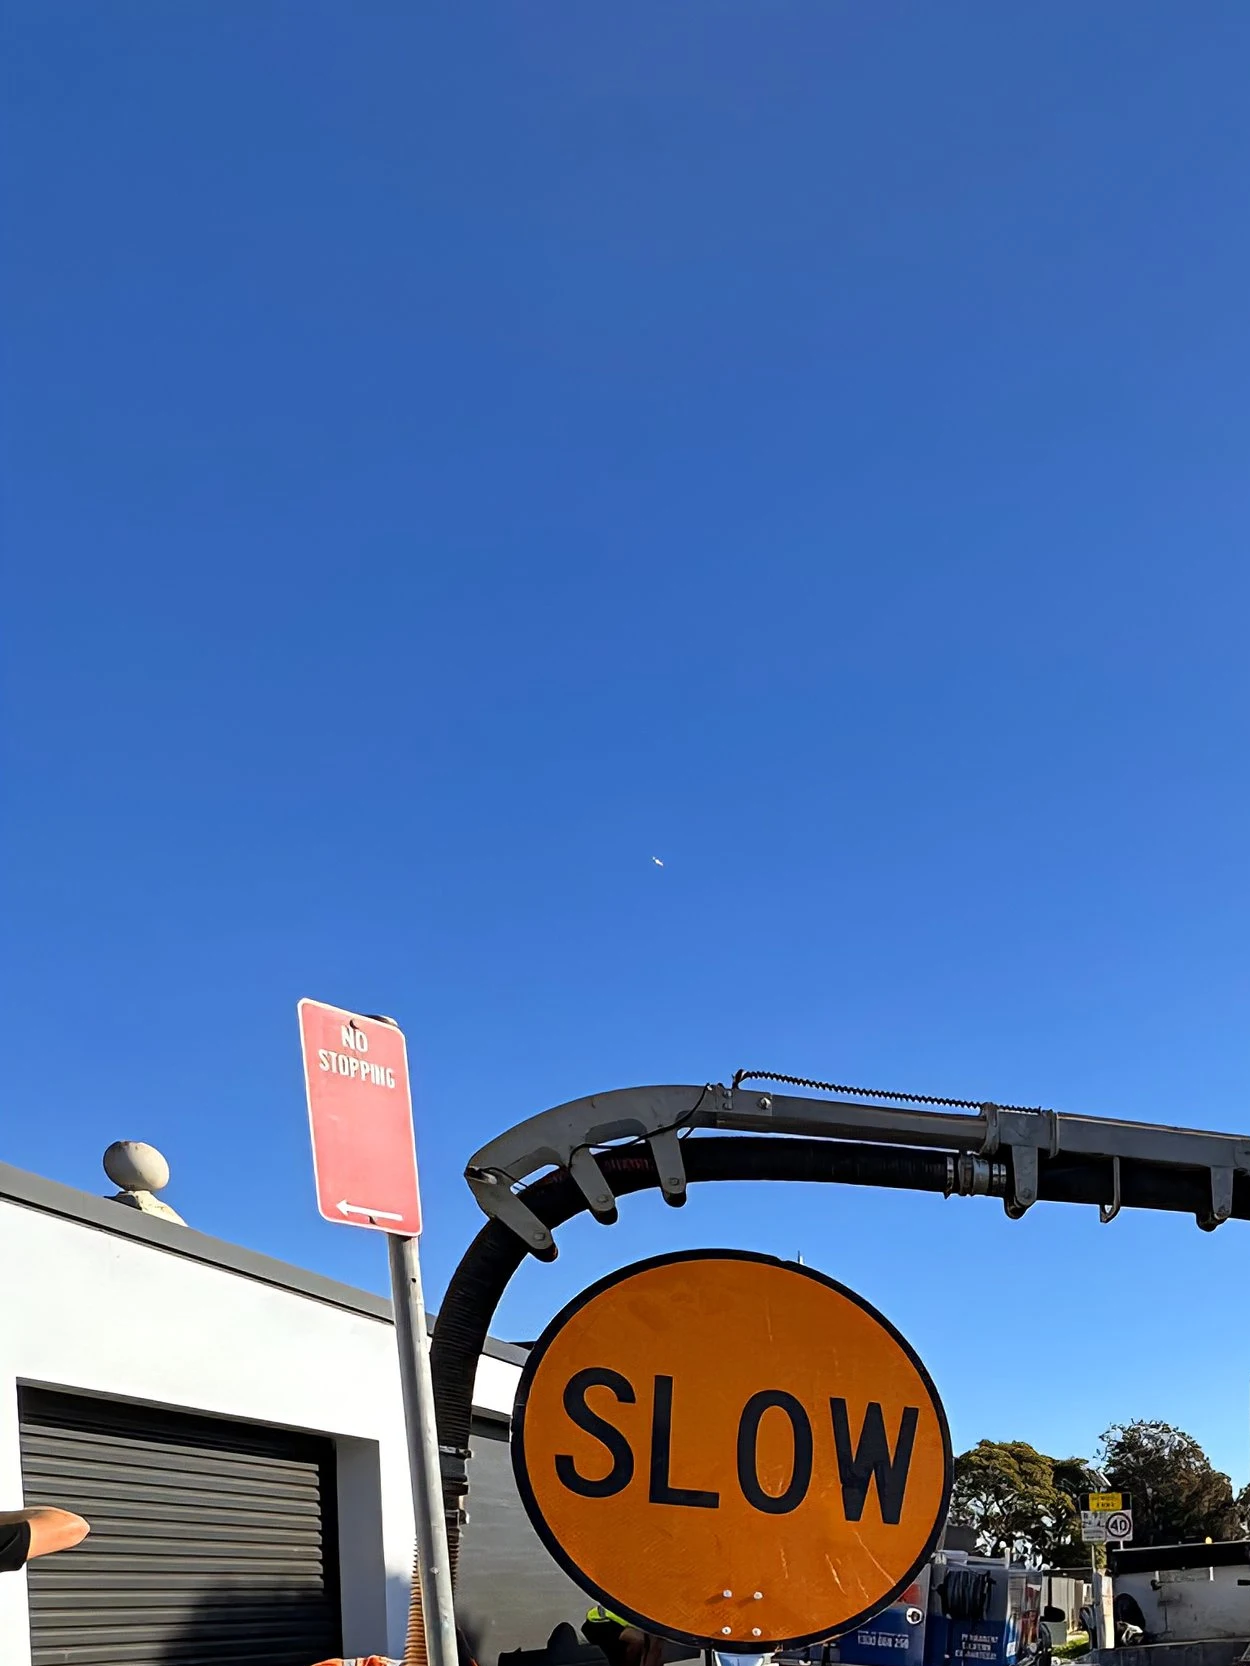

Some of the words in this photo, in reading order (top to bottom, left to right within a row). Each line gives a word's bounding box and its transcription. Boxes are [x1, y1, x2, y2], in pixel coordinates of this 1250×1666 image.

[341, 1025, 368, 1053] NO
[318, 1049, 396, 1089] STOPPING
[554, 1366, 920, 1525] SLOW
[1110, 1519, 1127, 1532] 40
